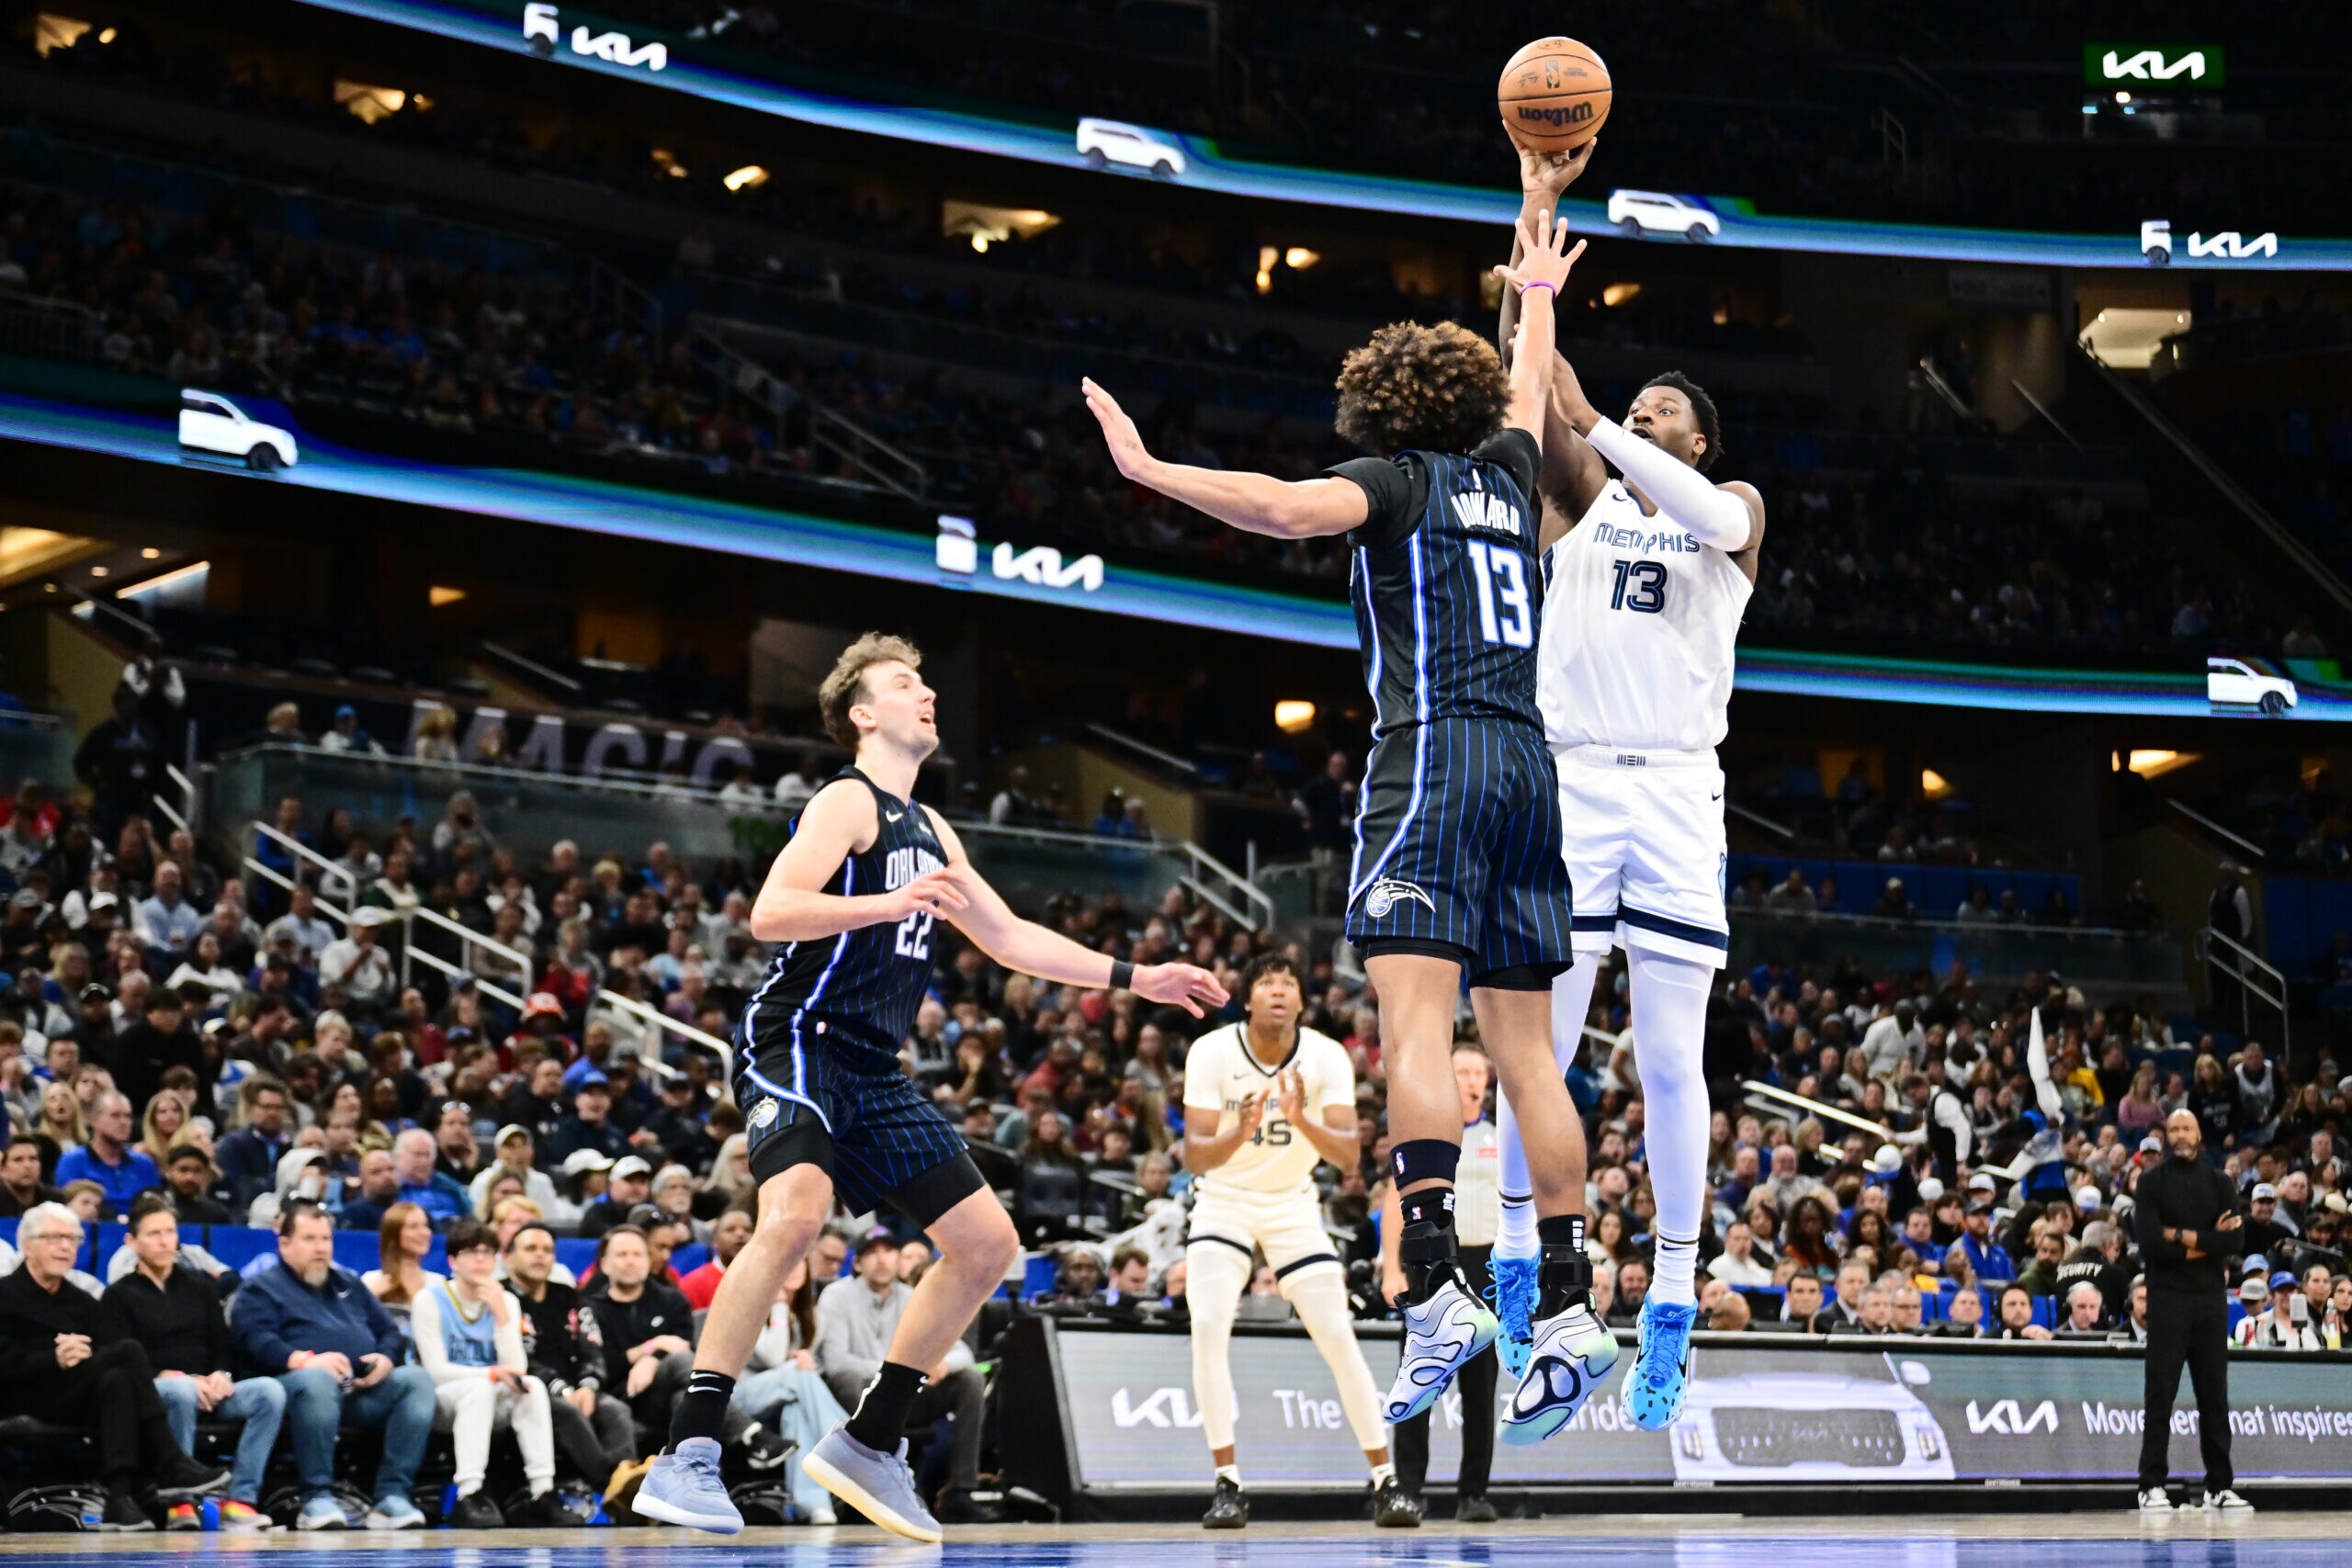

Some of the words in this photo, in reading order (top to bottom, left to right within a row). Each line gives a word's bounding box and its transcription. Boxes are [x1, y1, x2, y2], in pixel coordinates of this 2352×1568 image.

[2103, 51, 2205, 80] KIA
[1517, 101, 1594, 127] Wilson
[2188, 231, 2278, 258] KIA
[1593, 522, 1700, 555] MEMPHIS
[992, 542, 1104, 592] KIA
[1611, 558, 1668, 614] 13
[1467, 538, 1534, 649] 13
[895, 910, 933, 961] 22
[1272, 1389, 1342, 1429] The
[1965, 1399, 2059, 1435] KIA
